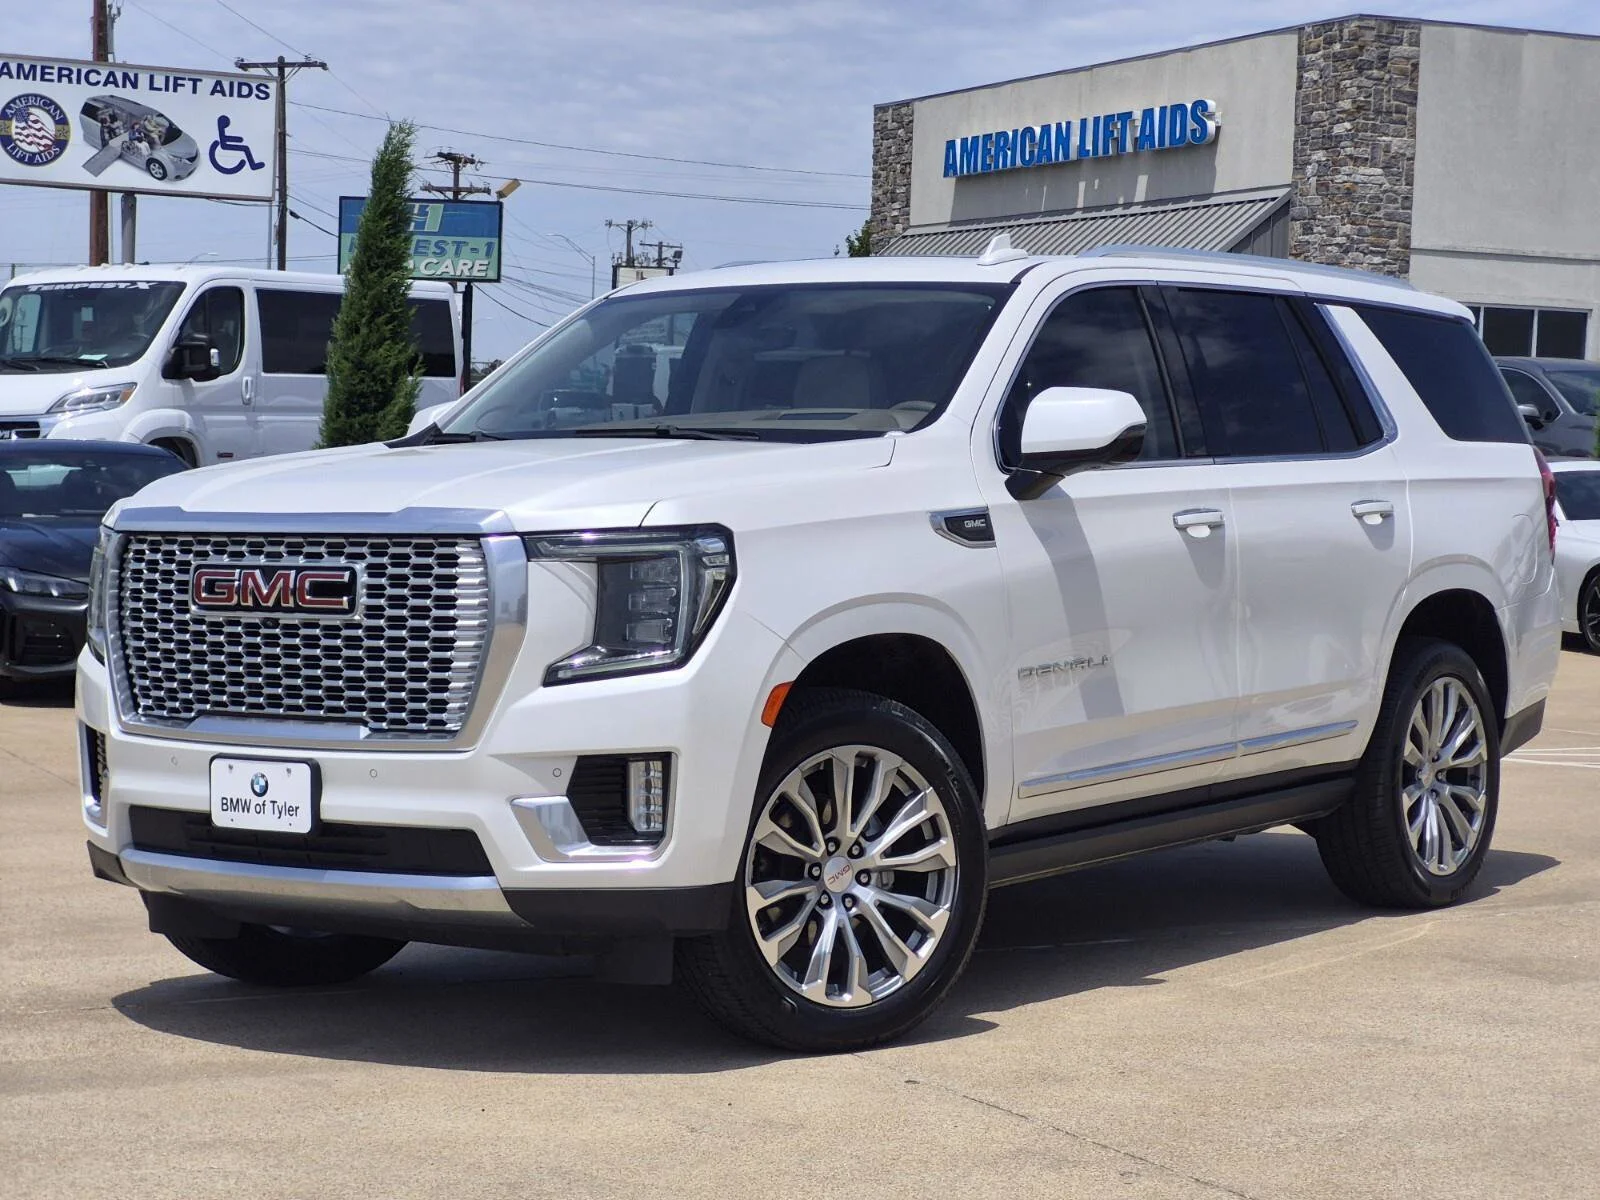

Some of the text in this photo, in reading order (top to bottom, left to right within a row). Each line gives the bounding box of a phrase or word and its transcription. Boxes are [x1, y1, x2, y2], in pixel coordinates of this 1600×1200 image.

[0, 62, 270, 100] AMERICAN LIFT AIDS
[5, 96, 64, 121] AMERICAN
[943, 99, 1212, 178] AMERICAN LIFT AIDS
[7, 143, 60, 163] LIFT AIDS
[420, 258, 489, 277] CARE
[964, 519, 986, 528] GMC
[194, 569, 349, 609] GMC
[221, 797, 299, 819] BMW of Tyler
[828, 865, 850, 884] GMC
